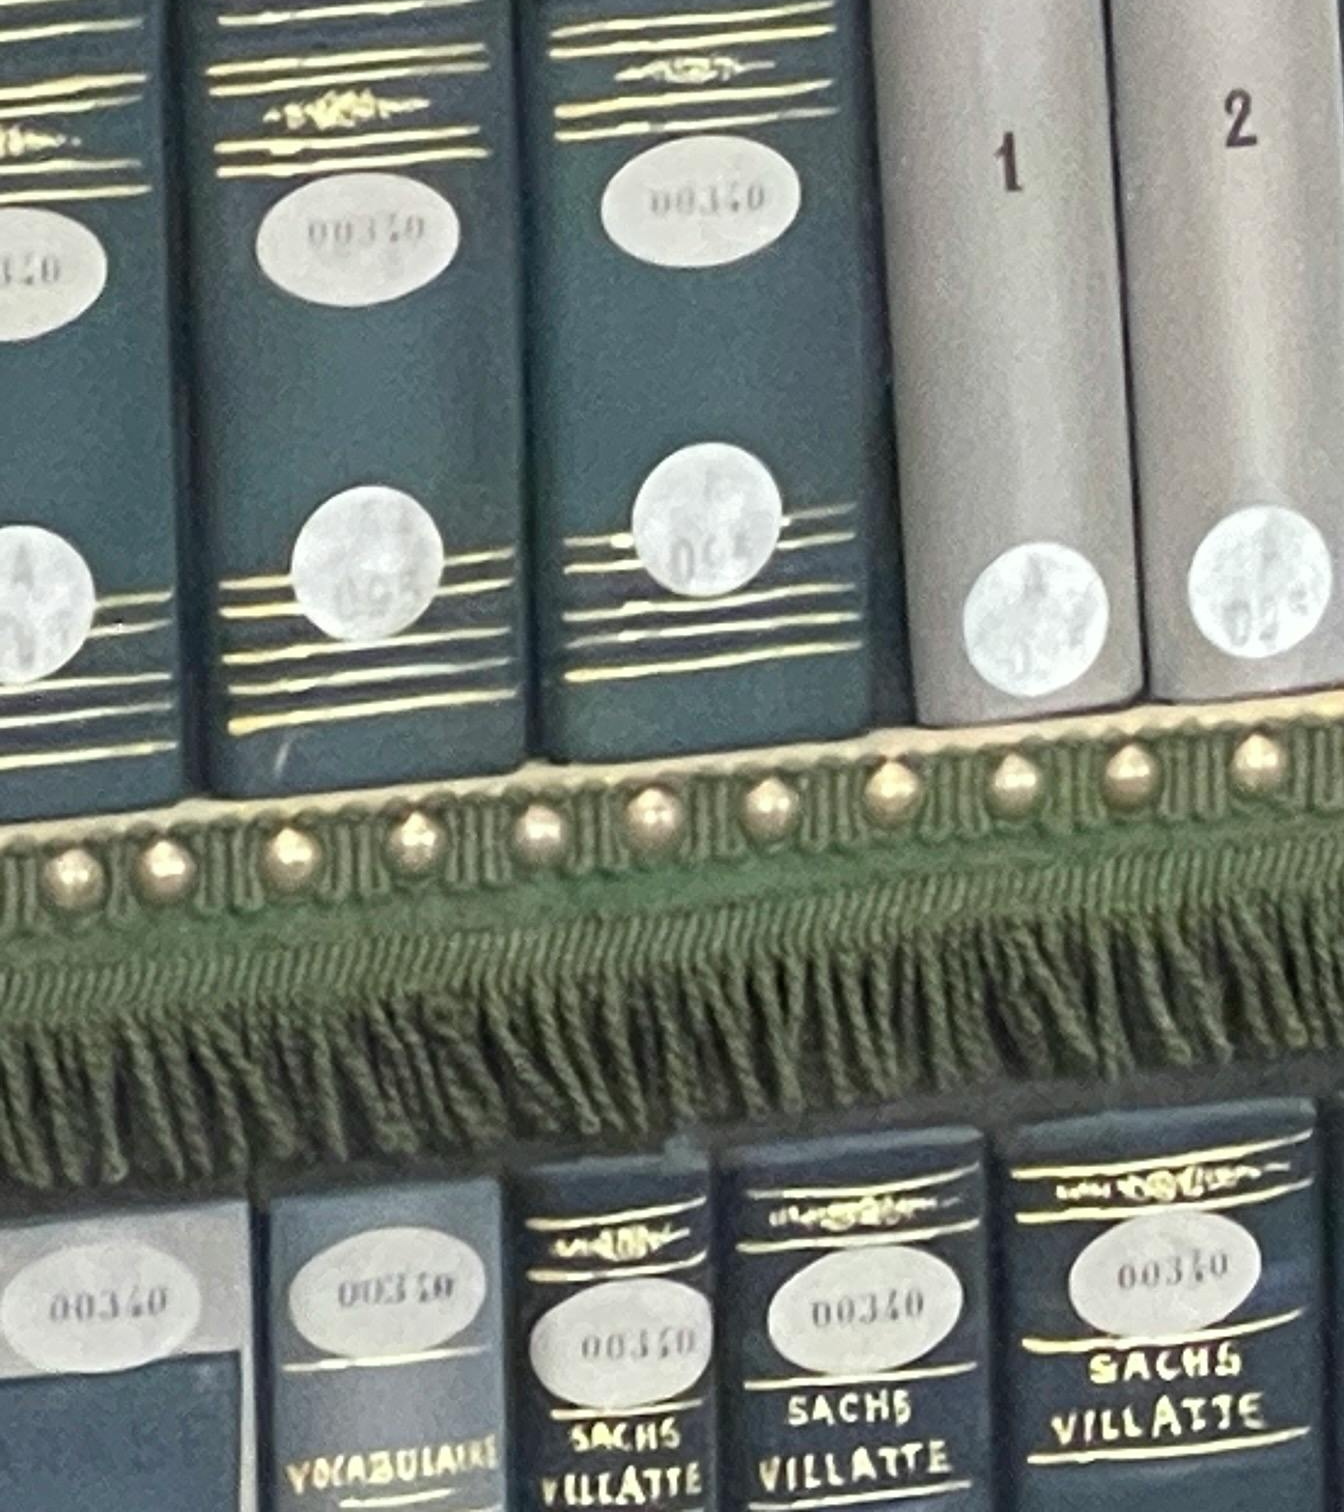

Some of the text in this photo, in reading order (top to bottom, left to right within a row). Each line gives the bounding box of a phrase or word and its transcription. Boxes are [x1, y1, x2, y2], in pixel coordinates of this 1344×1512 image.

[1222, 88, 1259, 148] 2
[993, 130, 1023, 192] 1
[1088, 1346, 1244, 1387] SACHS
[786, 1387, 913, 1427] SACHS
[1049, 1392, 1270, 1448] VILLATTE
[569, 1417, 682, 1452] SACHS
[541, 1460, 702, 1508] VILLATTE
[758, 1439, 953, 1491] VILLATTE
